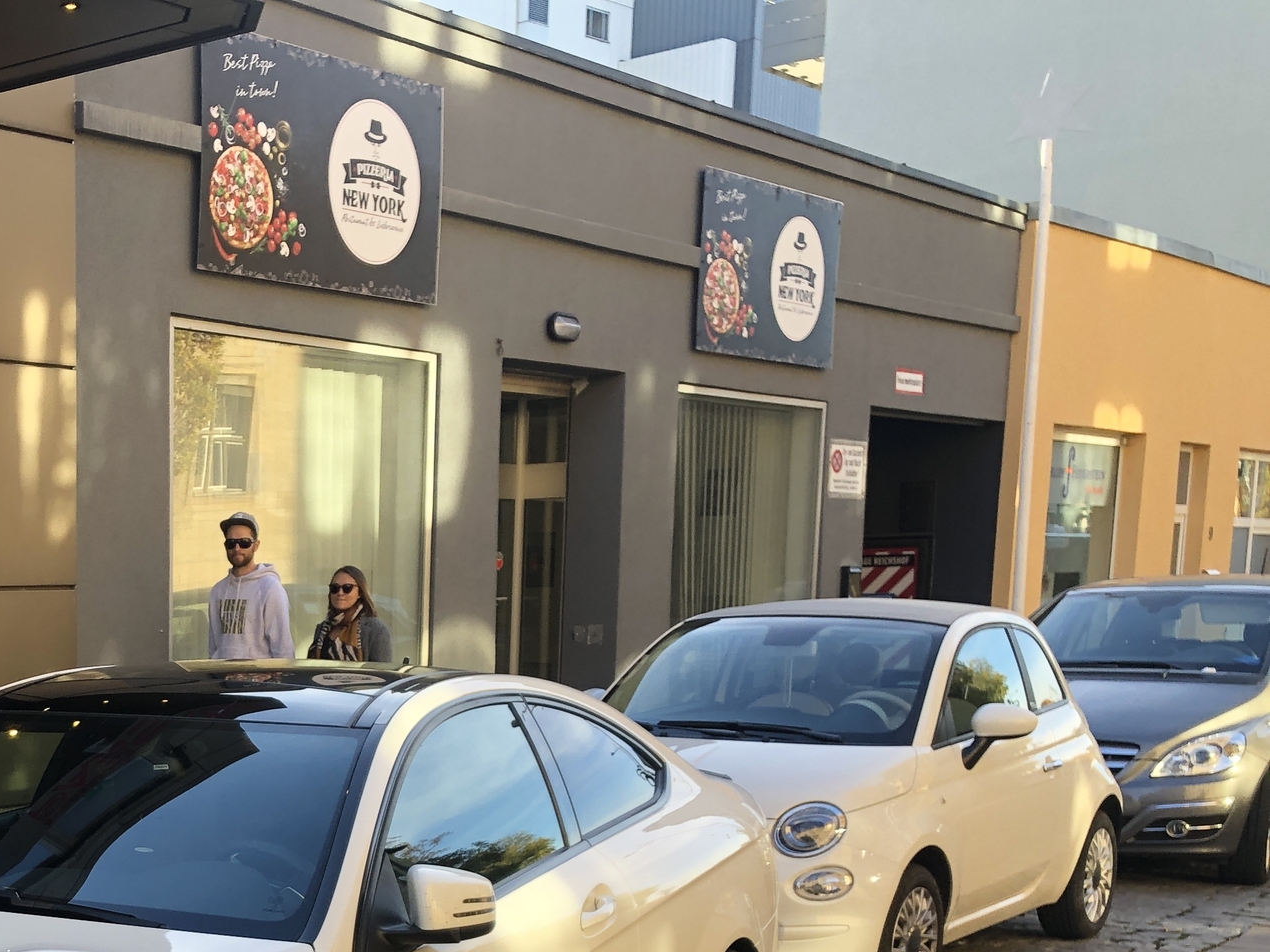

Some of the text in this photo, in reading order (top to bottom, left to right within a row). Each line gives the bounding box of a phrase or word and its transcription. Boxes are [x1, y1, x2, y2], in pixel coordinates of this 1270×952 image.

[222, 53, 247, 72] Best
[235, 81, 279, 98] in town!
[356, 163, 395, 183] PIZZERIA
[342, 188, 408, 223] NEW YORK
[778, 285, 816, 309] NEW YORK
